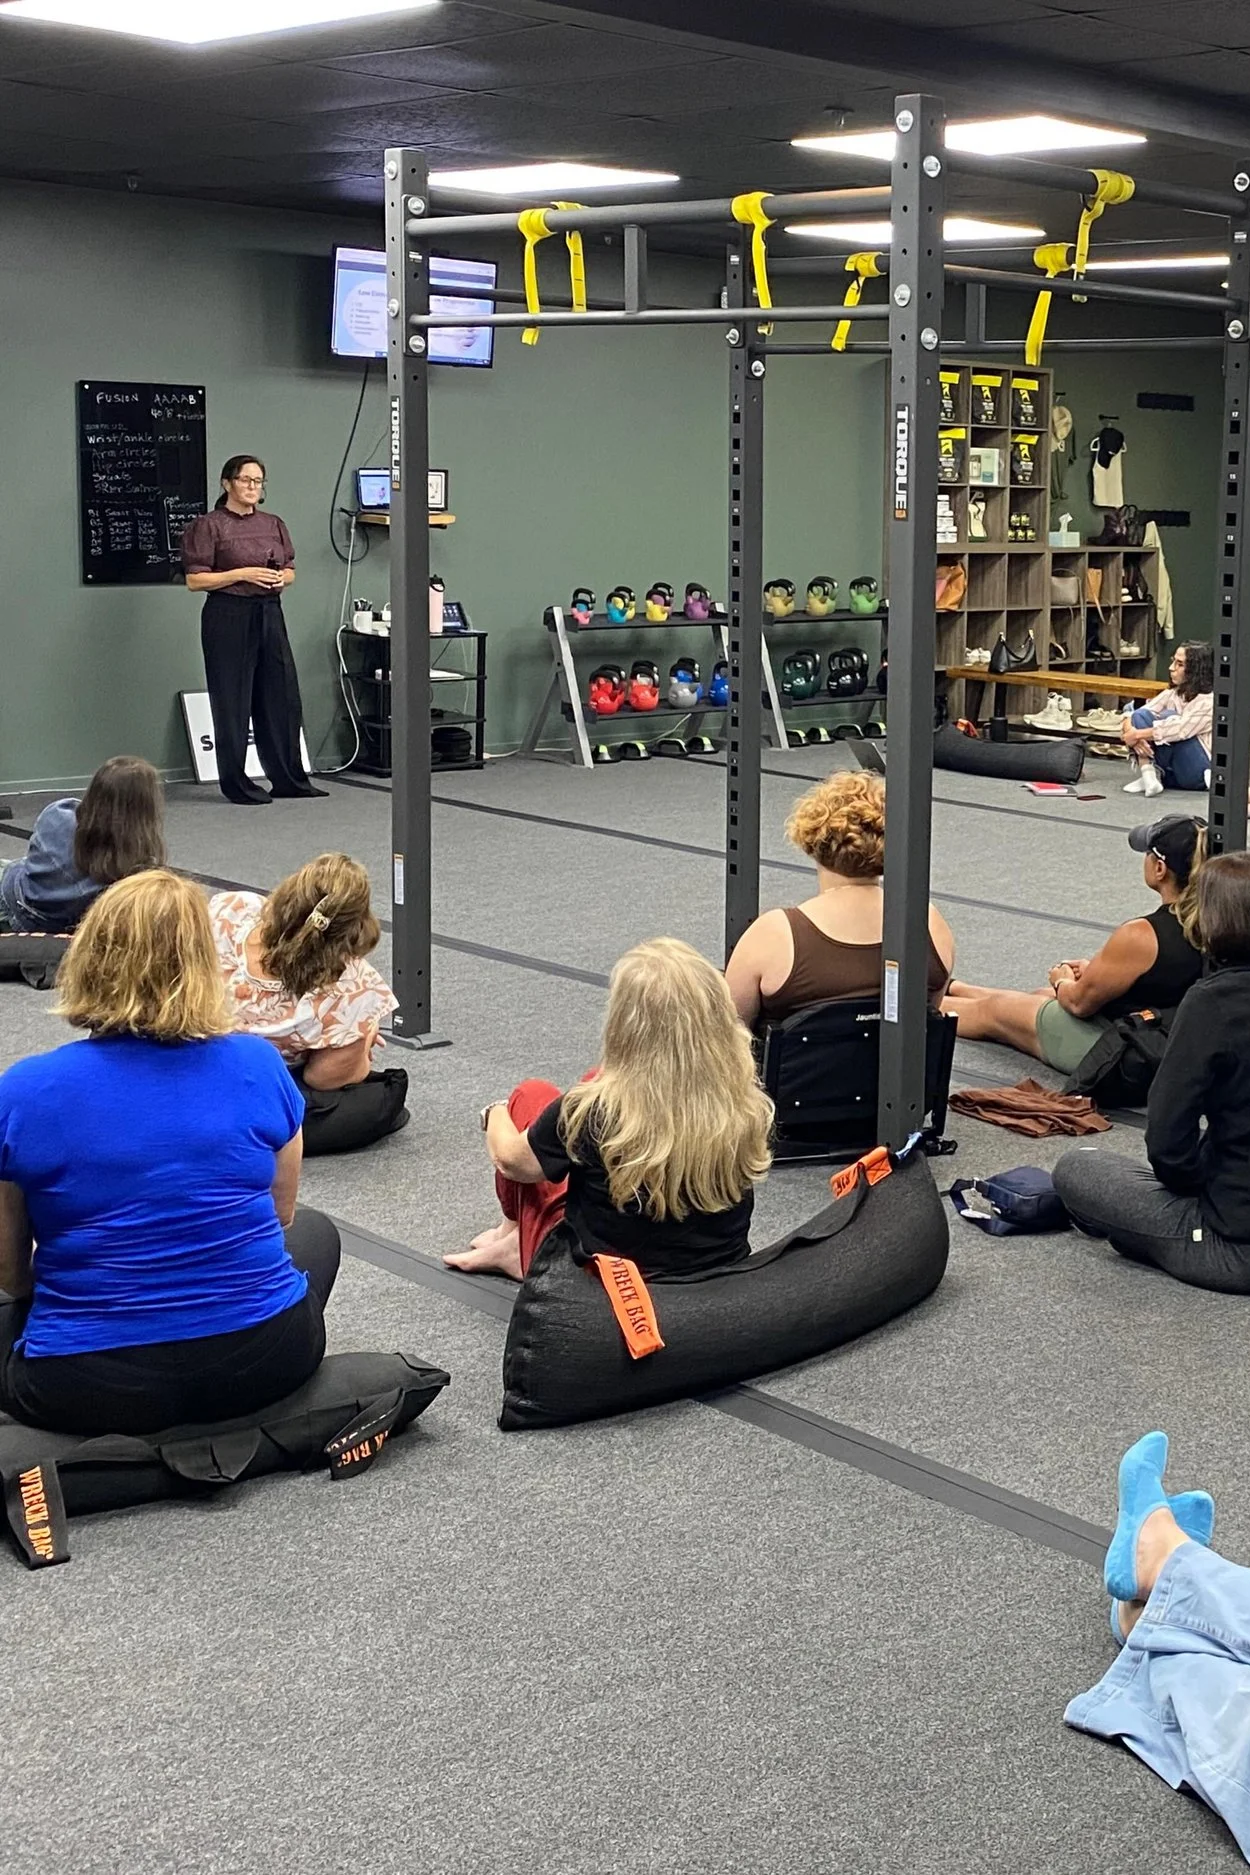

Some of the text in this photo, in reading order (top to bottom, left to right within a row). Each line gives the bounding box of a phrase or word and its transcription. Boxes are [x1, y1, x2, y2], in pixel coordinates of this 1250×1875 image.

[391, 397, 400, 482] TORQUE
[895, 406, 909, 509] TORQUE
[610, 1259, 651, 1336] WRECK BAG
[19, 1465, 53, 1556] WRECK BAG
